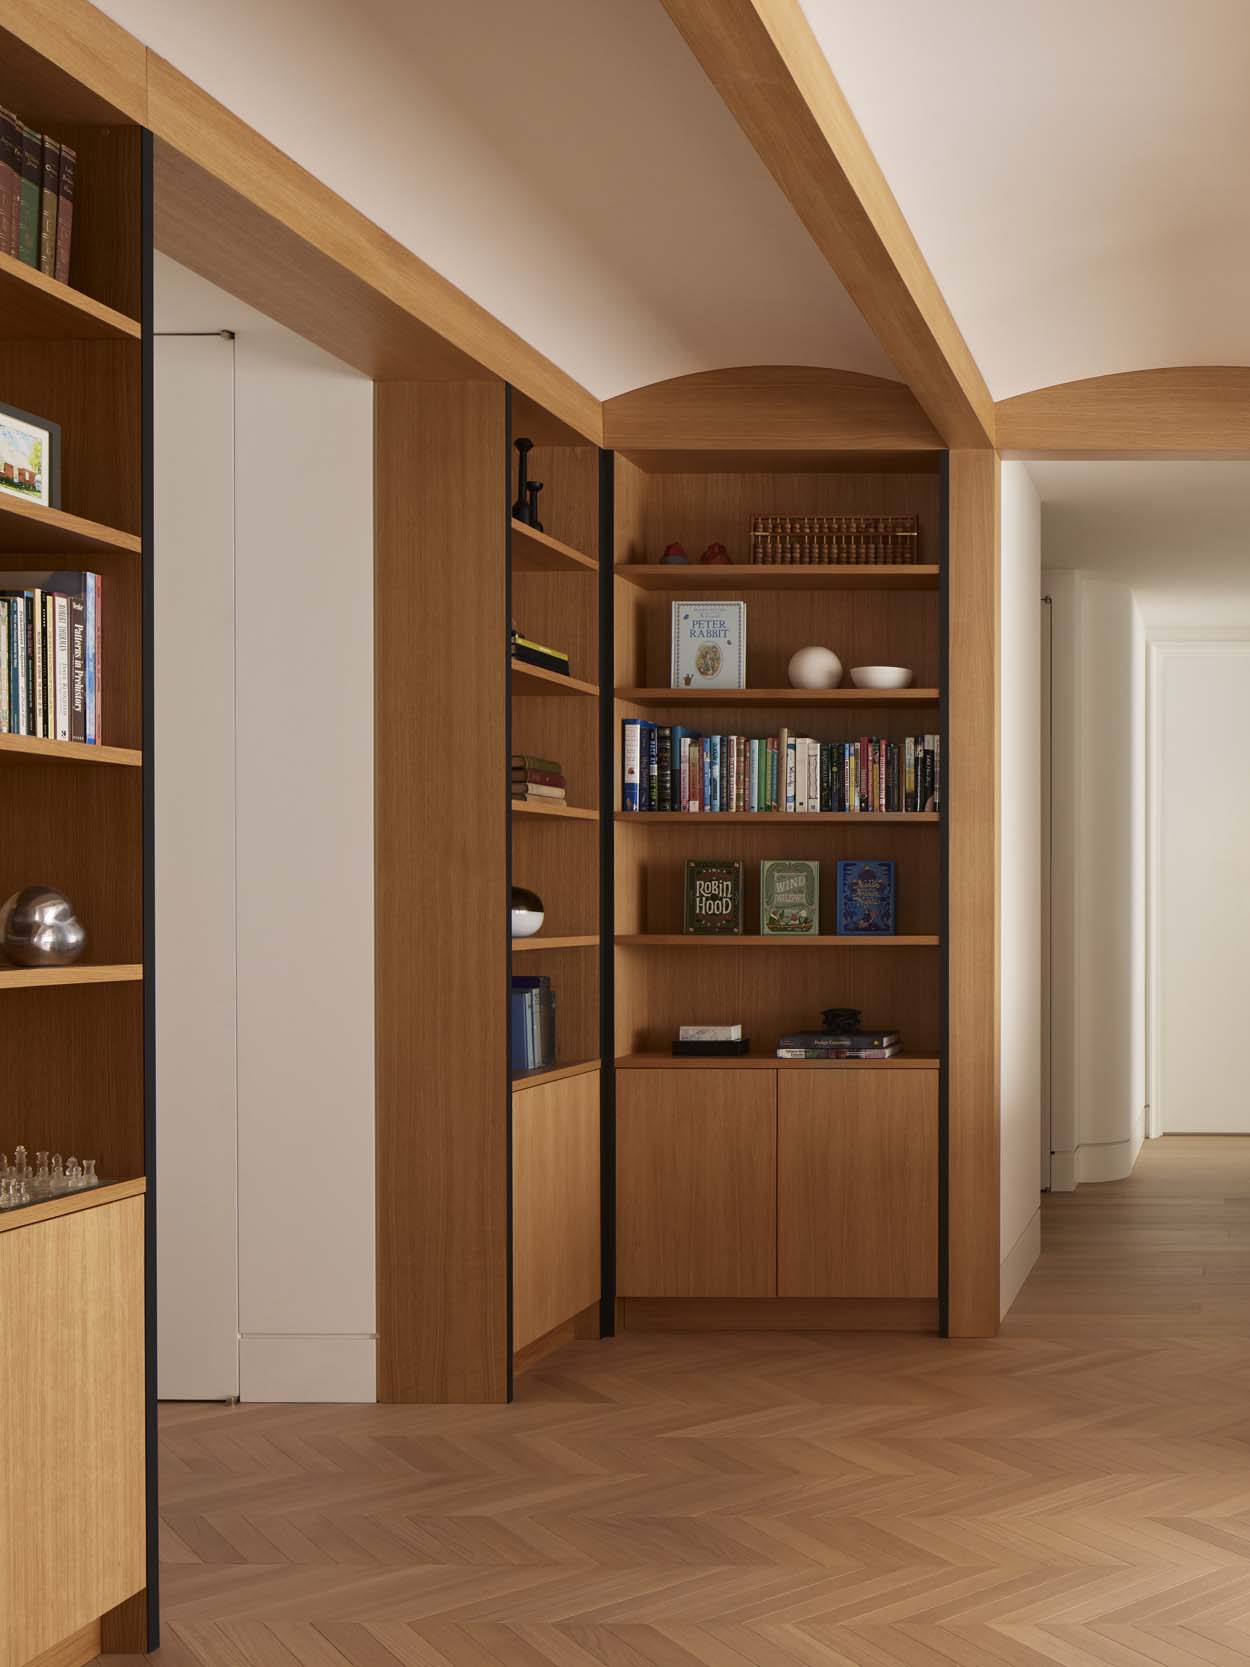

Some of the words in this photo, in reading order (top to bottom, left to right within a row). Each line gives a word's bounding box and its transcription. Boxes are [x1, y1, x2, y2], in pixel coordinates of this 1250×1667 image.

[692, 619, 726, 629] PETER
[689, 629, 729, 638] RABBIT
[74, 623, 84, 659] Patterns
[74, 660, 83, 669] in
[73, 669, 84, 712] Prehistory
[776, 876, 806, 892] WIND
